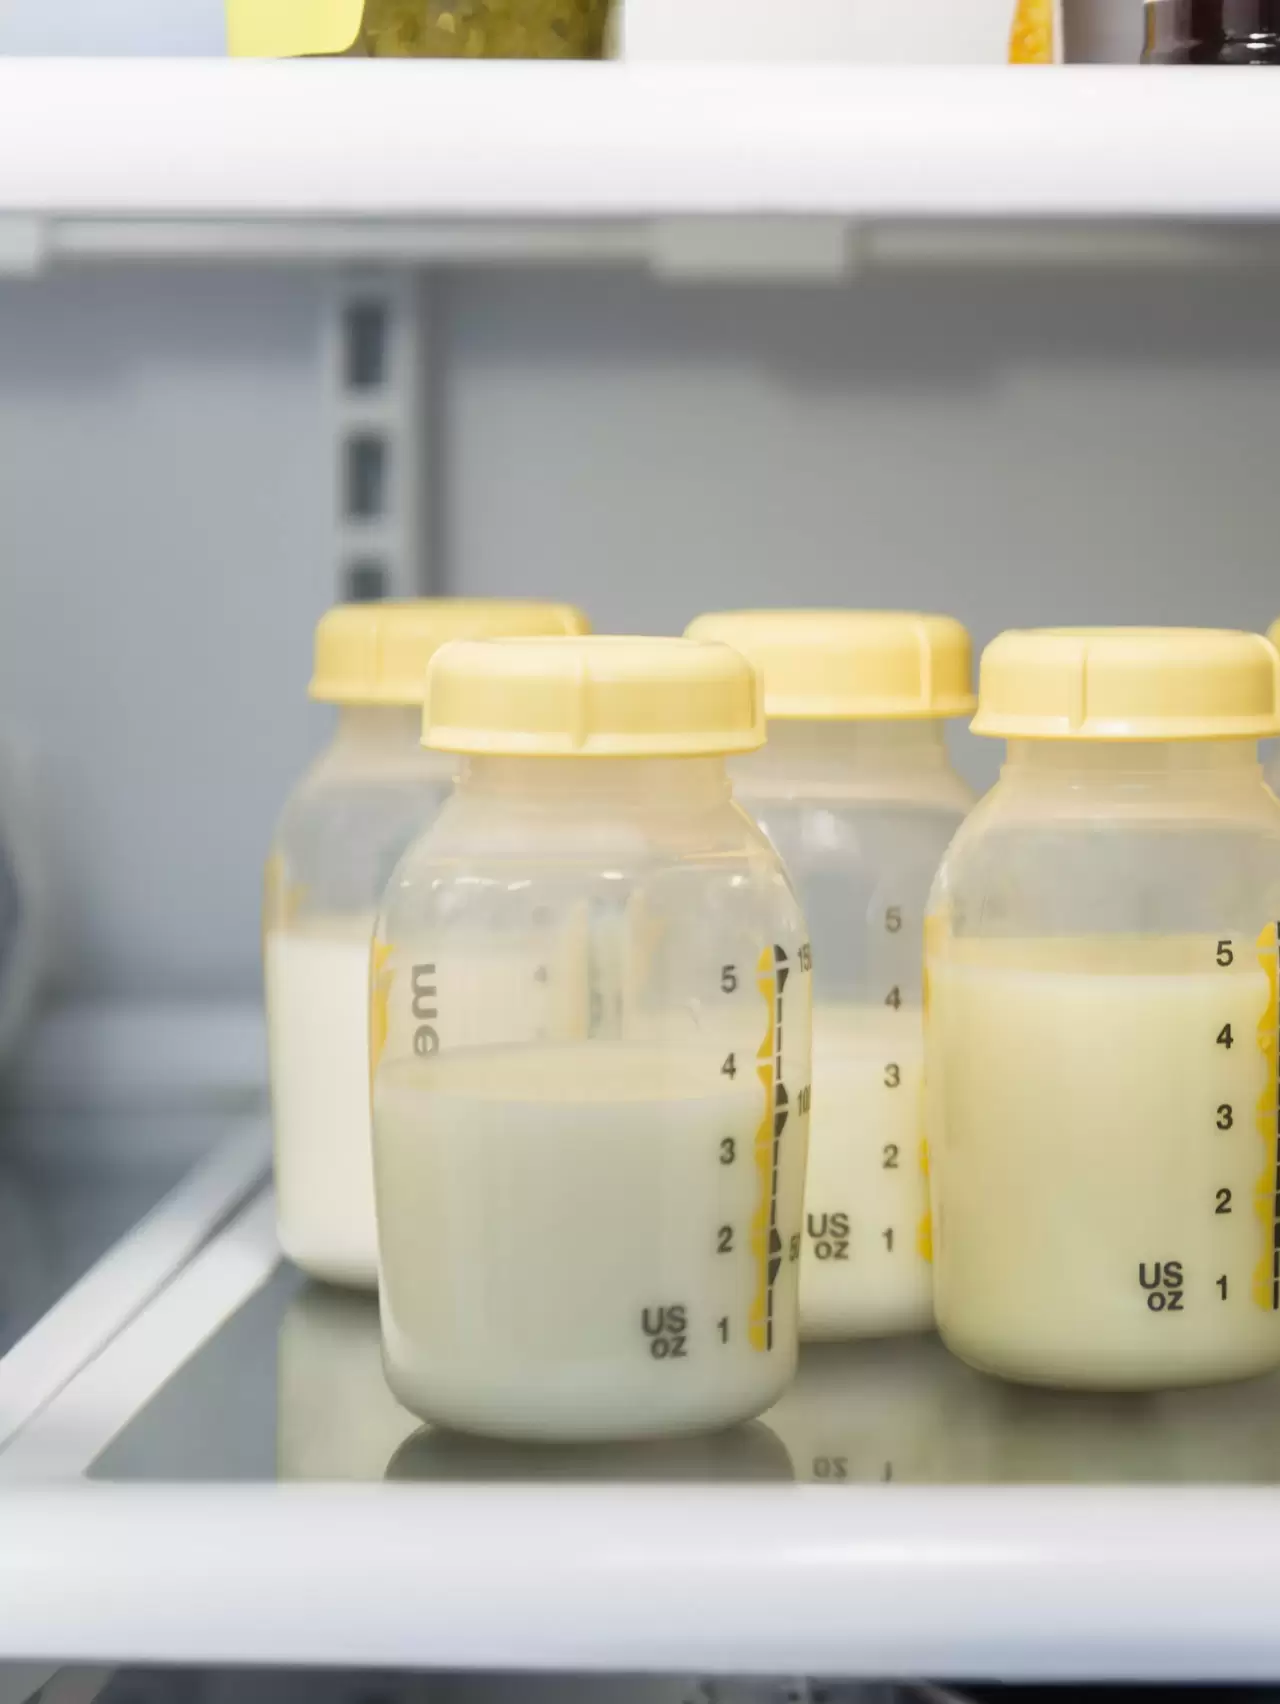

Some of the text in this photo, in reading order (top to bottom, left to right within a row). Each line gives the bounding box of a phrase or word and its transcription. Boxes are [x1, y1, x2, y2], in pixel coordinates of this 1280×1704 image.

[884, 906, 902, 933] 5
[1216, 940, 1233, 967] 5
[720, 964, 738, 994] 5
[884, 984, 901, 1011] 4
[1216, 1023, 1234, 1050] 4
[720, 1052, 737, 1081] 4
[883, 1062, 901, 1088] 3
[1216, 1104, 1233, 1131] 3
[719, 1137, 736, 1165] 3
[882, 1143, 899, 1169] 2
[1214, 1187, 1232, 1214] 2
[806, 1212, 850, 1238] US
[717, 1225, 734, 1253] 2
[814, 1240, 850, 1260] oz
[881, 1227, 894, 1253] 1
[1138, 1261, 1184, 1289] US
[1215, 1274, 1228, 1301] 1
[1147, 1290, 1184, 1313] oz
[641, 1305, 688, 1337] US
[716, 1316, 728, 1345] 1
[650, 1335, 688, 1359] oz
